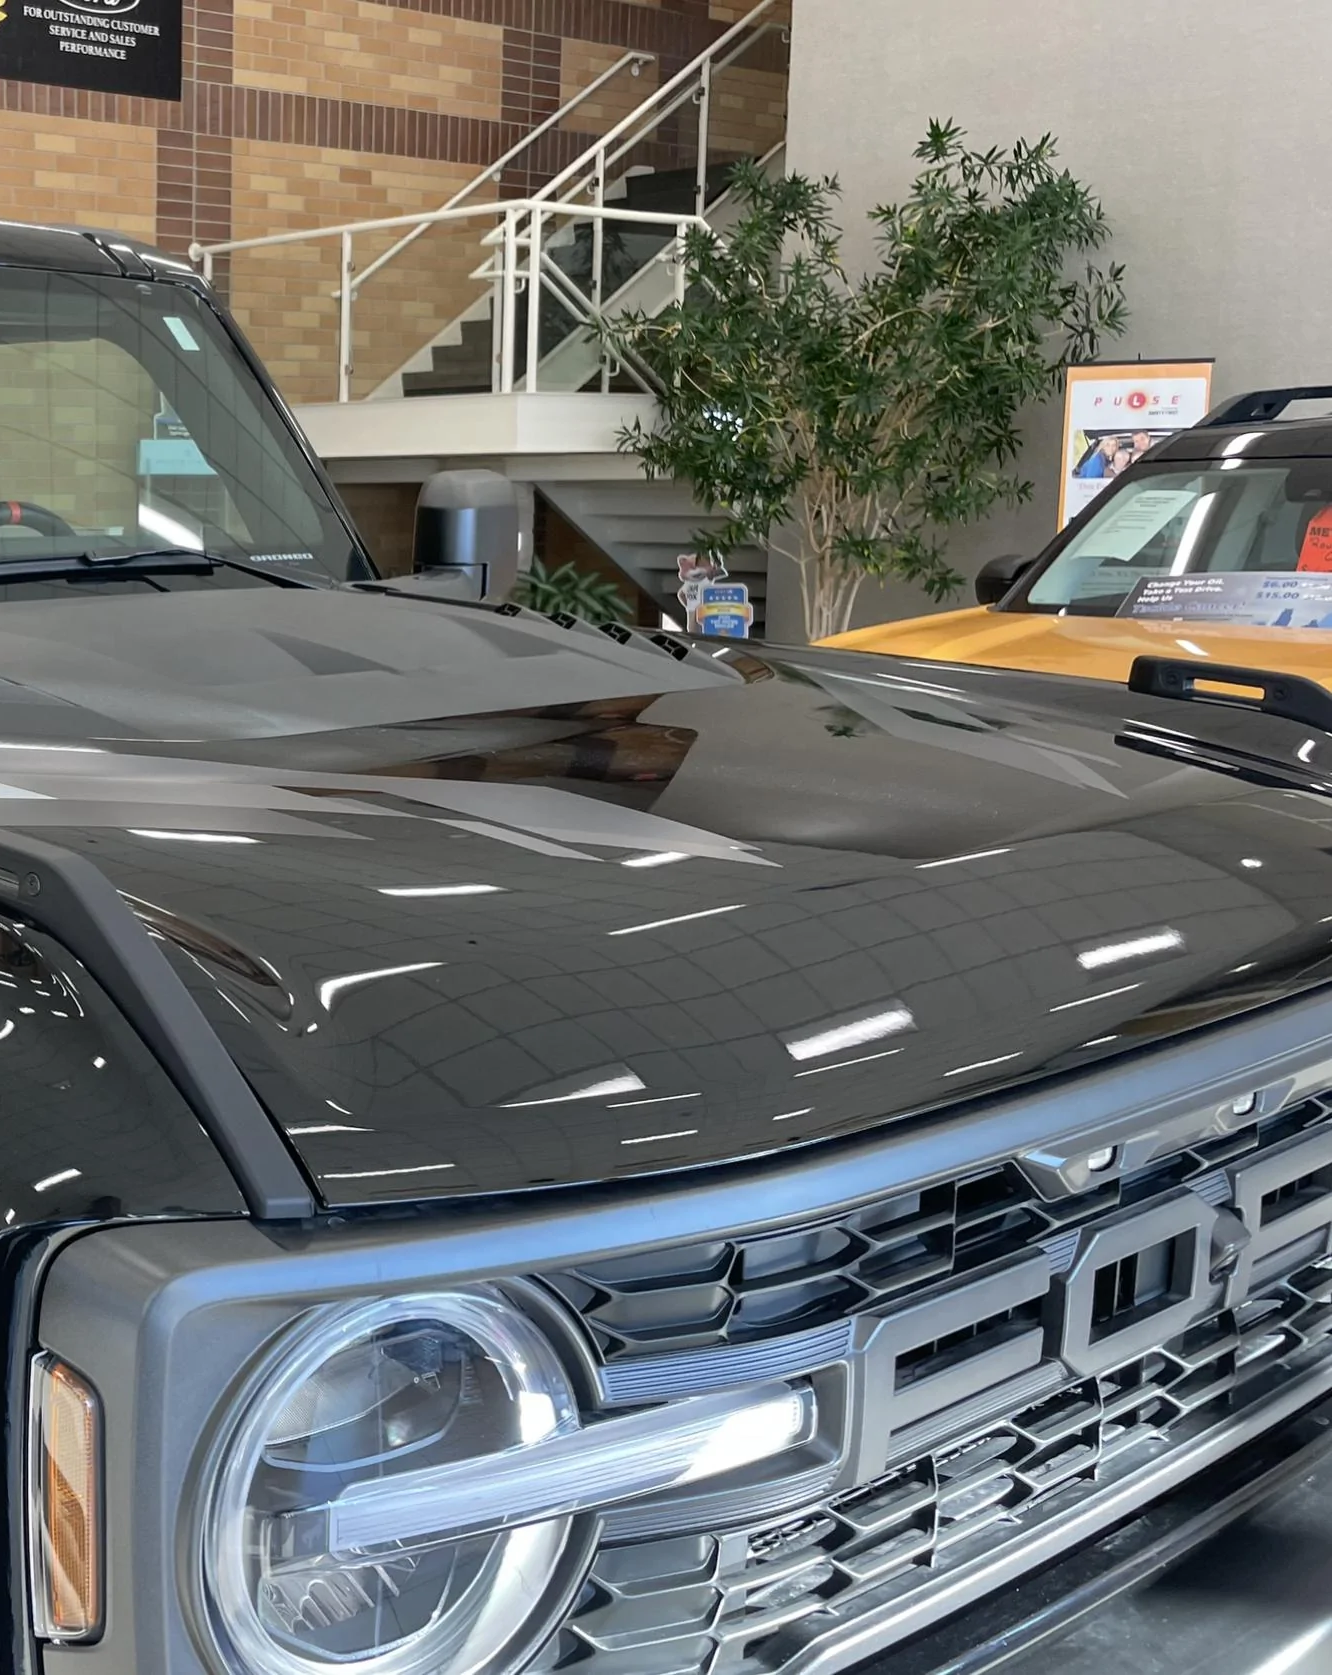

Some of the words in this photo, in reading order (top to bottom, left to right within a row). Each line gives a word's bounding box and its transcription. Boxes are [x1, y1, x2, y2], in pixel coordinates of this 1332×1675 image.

[23, 5, 43, 19] FOR
[43, 9, 110, 29] OUTSTANDING
[111, 20, 160, 37] CUSTOMER
[49, 24, 88, 40] SERVICE
[88, 31, 109, 43] AND
[109, 34, 137, 47] SALES
[59, 41, 127, 60] PERFORMANCE
[1093, 394, 1181, 407] PULSE
[1147, 581, 1182, 589] Change
[1143, 588, 1165, 596] Take
[1136, 595, 1160, 604] Help
